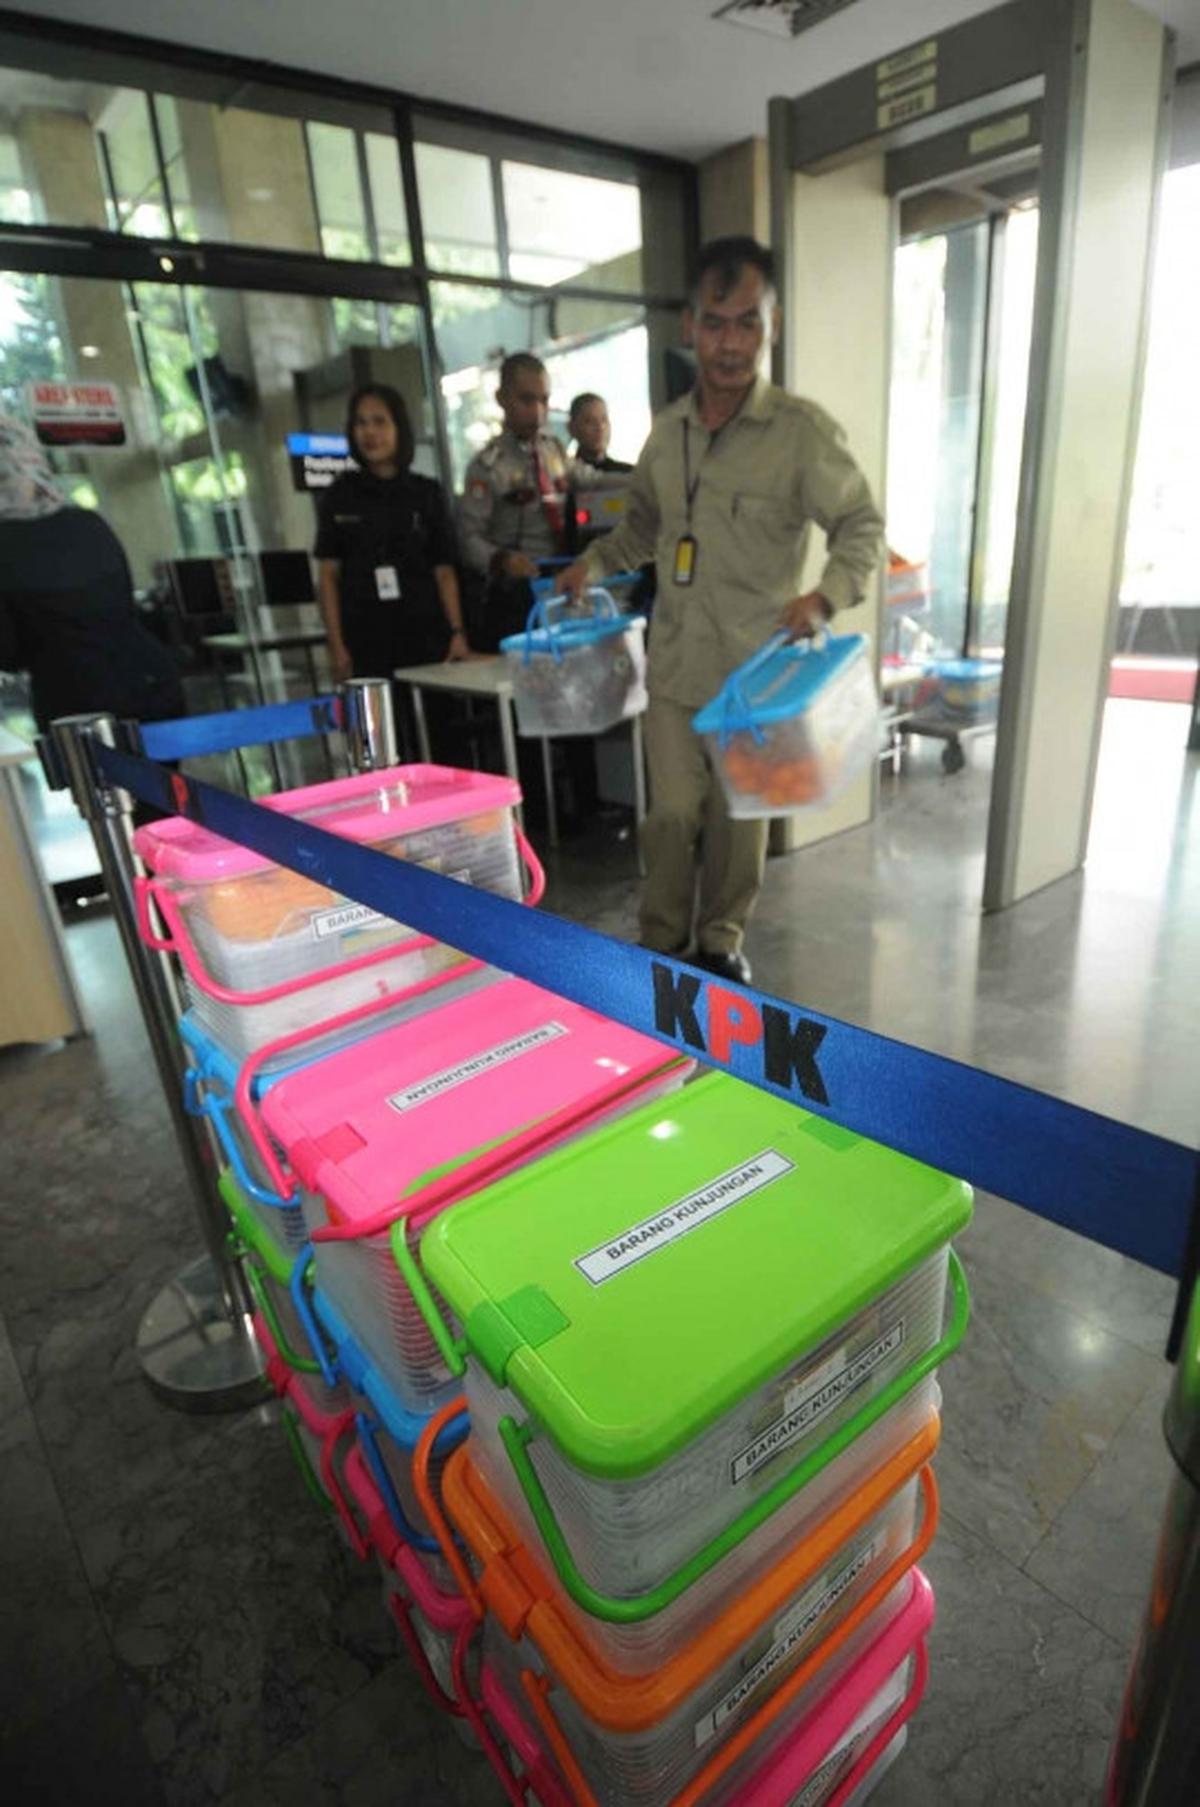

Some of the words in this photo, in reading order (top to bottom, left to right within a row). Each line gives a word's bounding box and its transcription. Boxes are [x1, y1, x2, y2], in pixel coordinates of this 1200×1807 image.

[326, 907, 376, 929] BARAN
[495, 1029, 550, 1057] BARANG
[651, 960, 830, 1107] KPK
[406, 1054, 494, 1102] KUNJUNGAN
[606, 1214, 676, 1261] BARANG
[674, 1163, 765, 1222] KUNJUNGAN
[745, 1409, 811, 1467] BARANG
[812, 1339, 894, 1413] KUNJUNGAN
